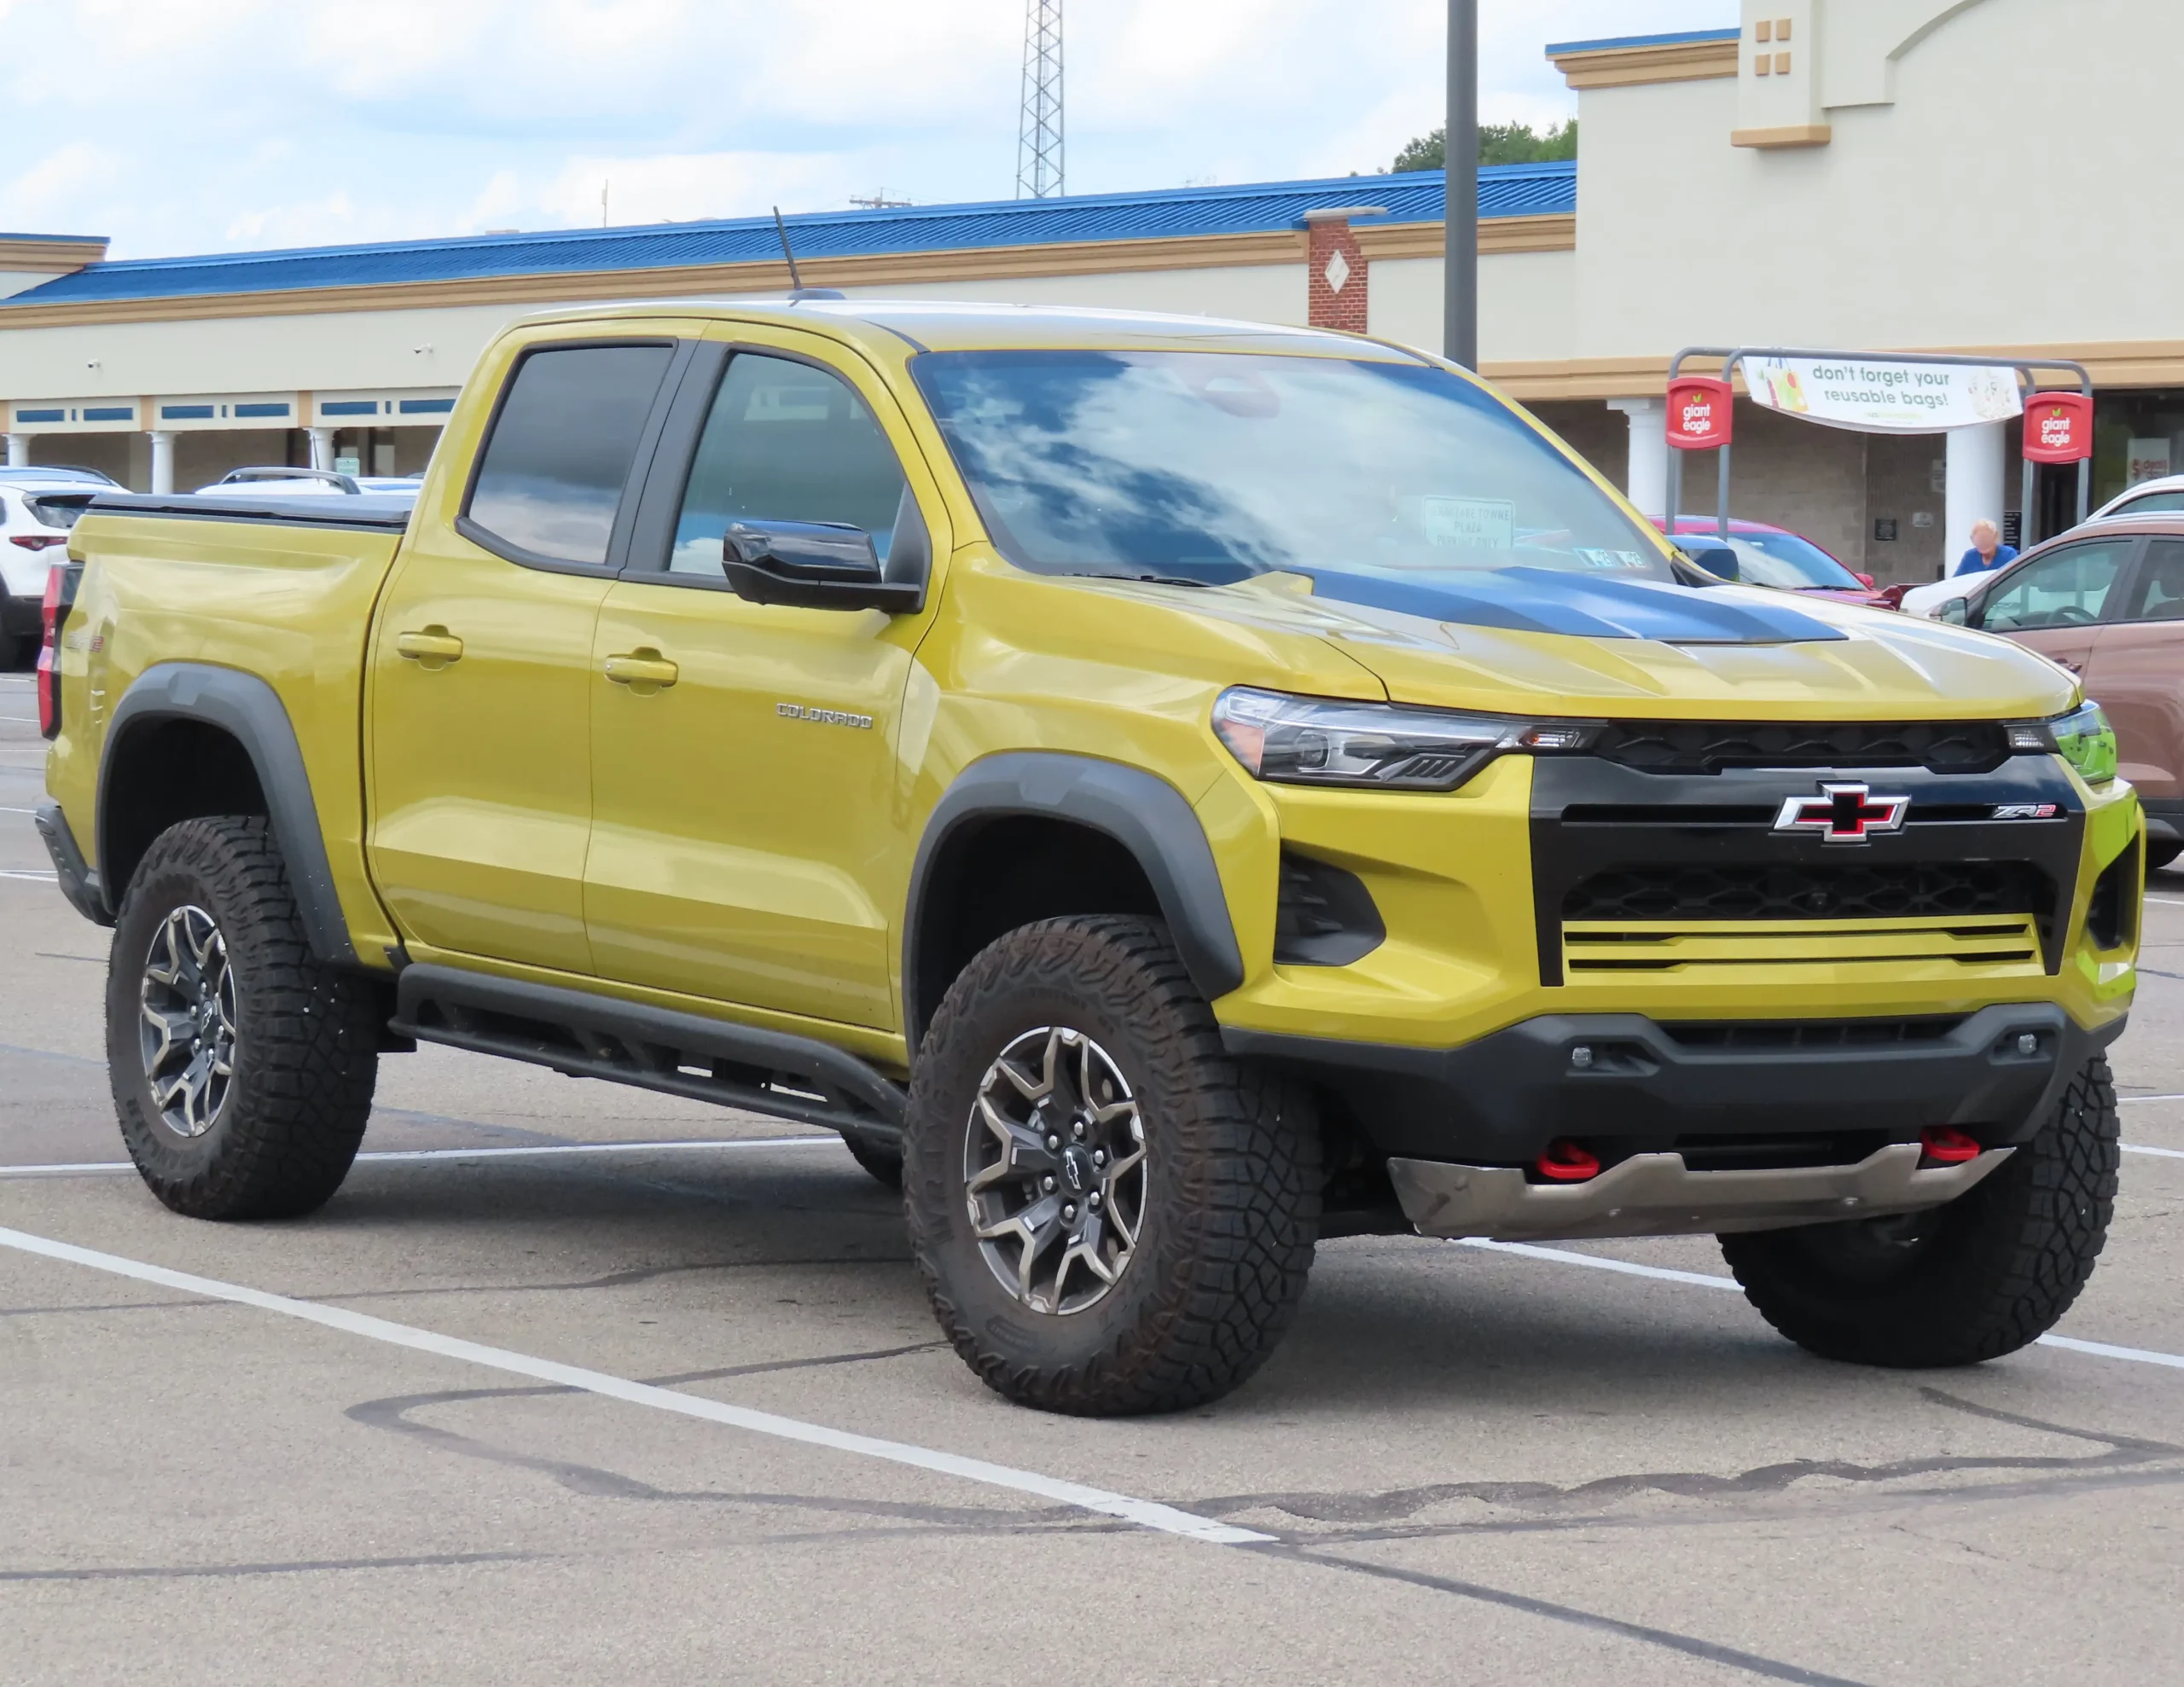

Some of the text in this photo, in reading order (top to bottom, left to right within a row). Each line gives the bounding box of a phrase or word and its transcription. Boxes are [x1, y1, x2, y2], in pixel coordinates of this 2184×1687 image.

[1812, 365, 1949, 387] don't forget your
[1824, 389, 1949, 409] reusable bags!
[1682, 403, 1711, 421] giant
[1682, 417, 1711, 434] eagle
[2042, 417, 2071, 434] giant
[2041, 430, 2071, 447] eagle
[776, 703, 873, 729] COLORADO
[1993, 804, 2057, 819] ZR2
